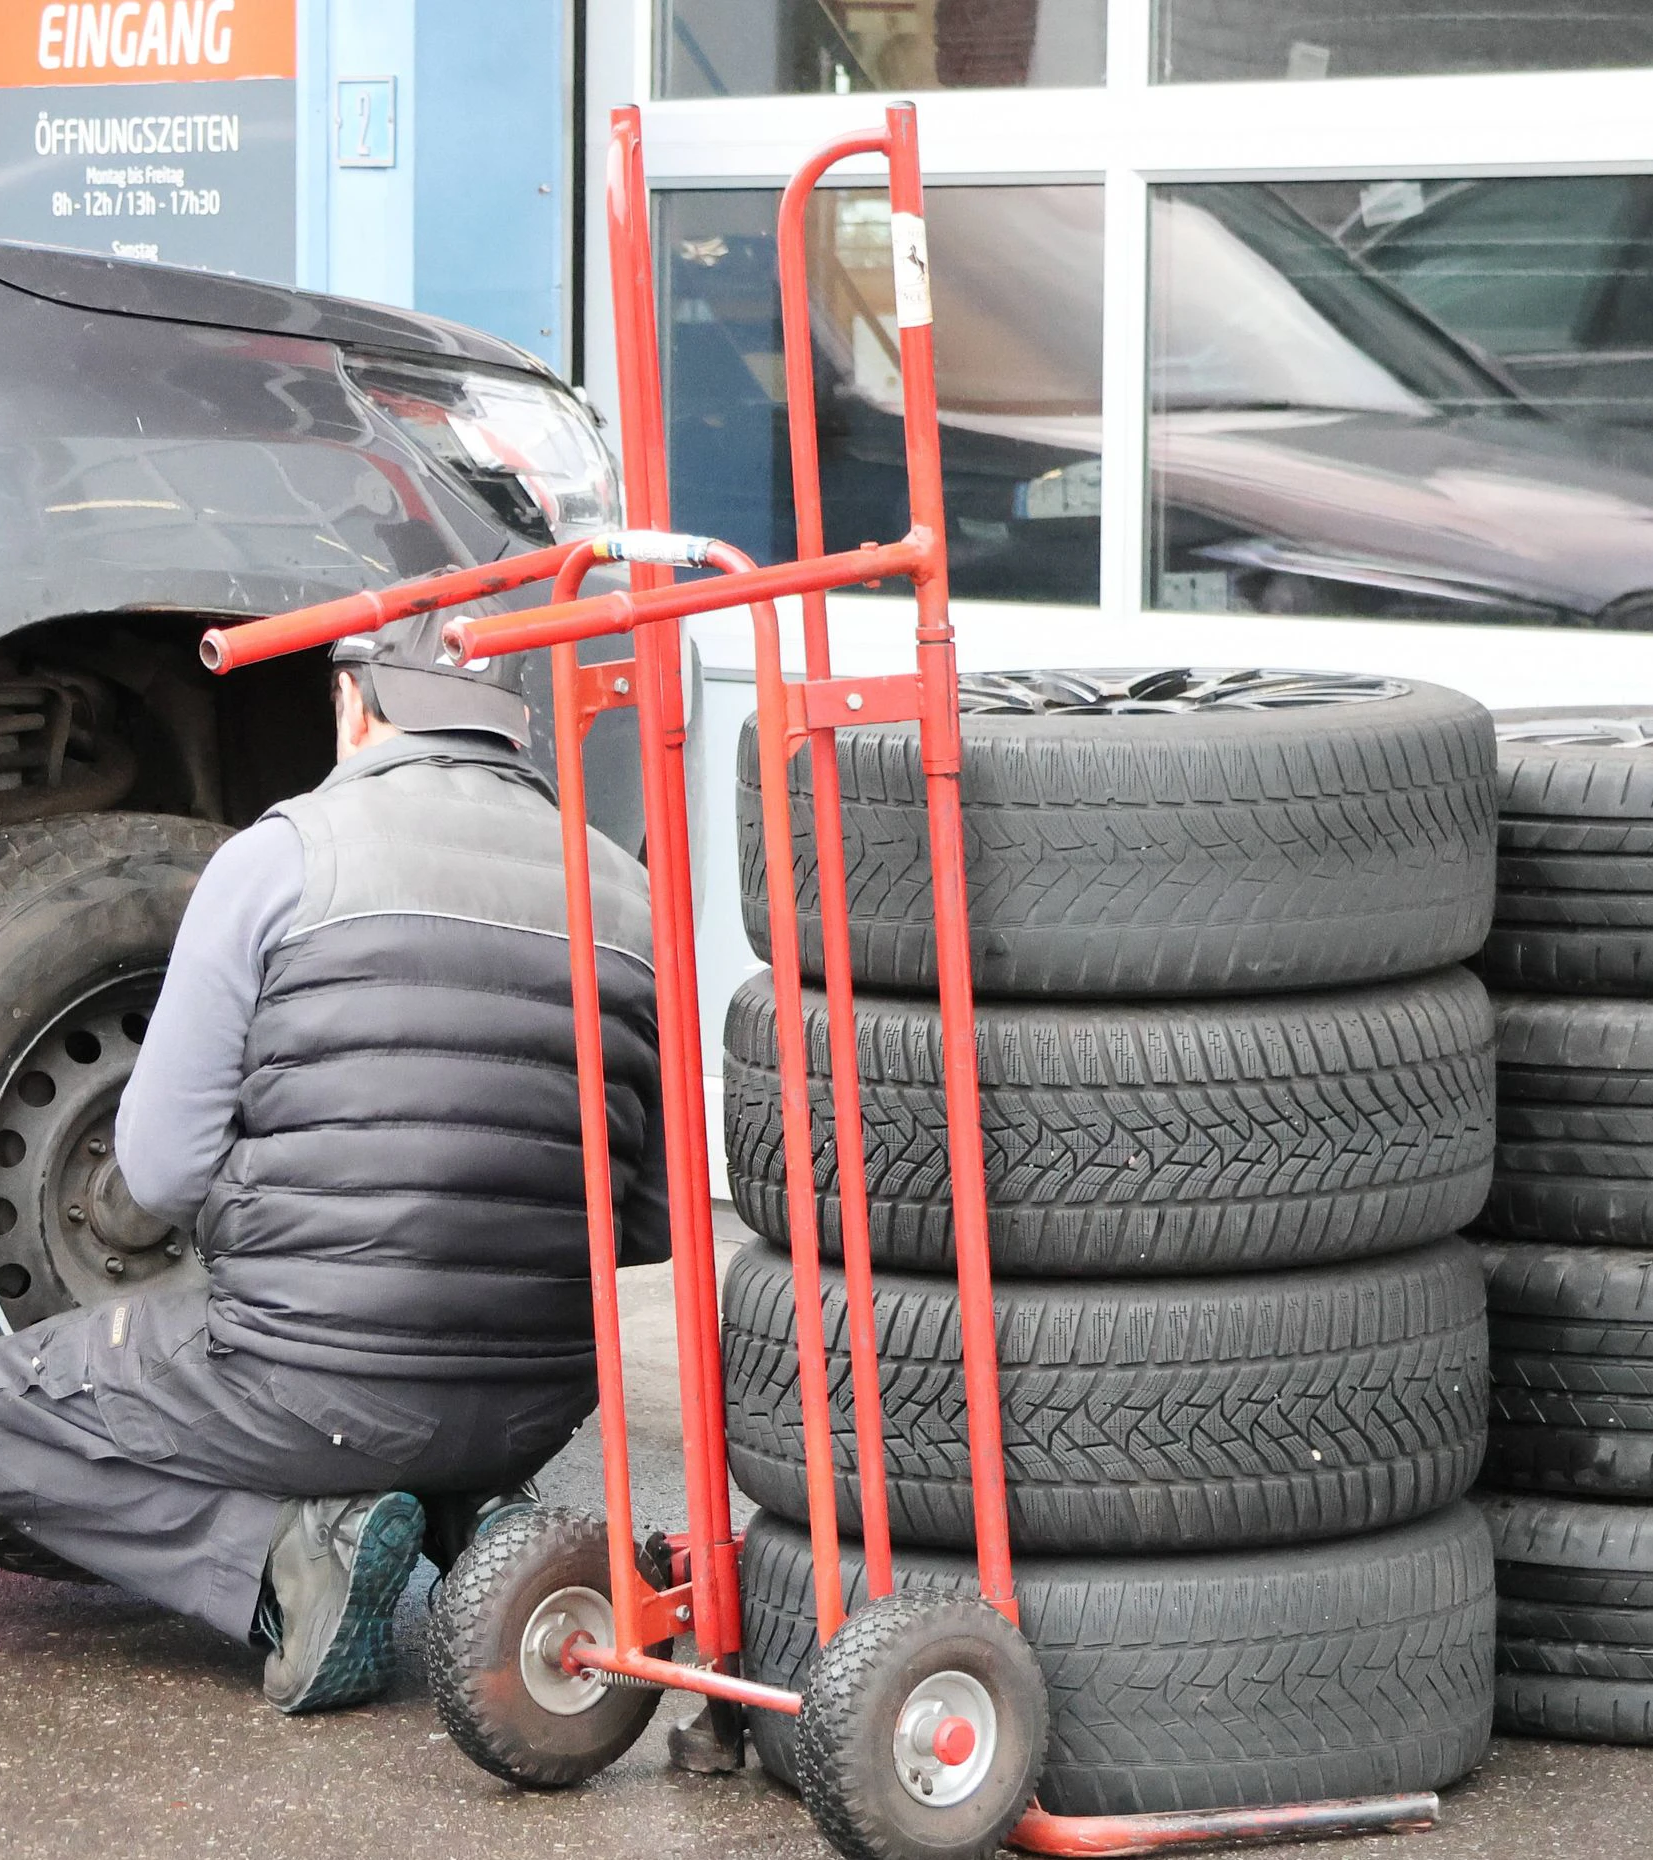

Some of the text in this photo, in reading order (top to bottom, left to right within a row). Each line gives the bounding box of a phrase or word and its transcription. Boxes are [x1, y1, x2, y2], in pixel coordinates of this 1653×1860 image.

[38, 0, 235, 70] EINGANG
[35, 111, 239, 155] ÖFFNUNGSZEITEN
[85, 165, 184, 188] Montag bis Freitag
[52, 191, 72, 216] 8h
[83, 190, 113, 216] 12h
[126, 190, 156, 216] 13h
[170, 189, 220, 215] 17h30
[111, 240, 159, 263] Samstag
